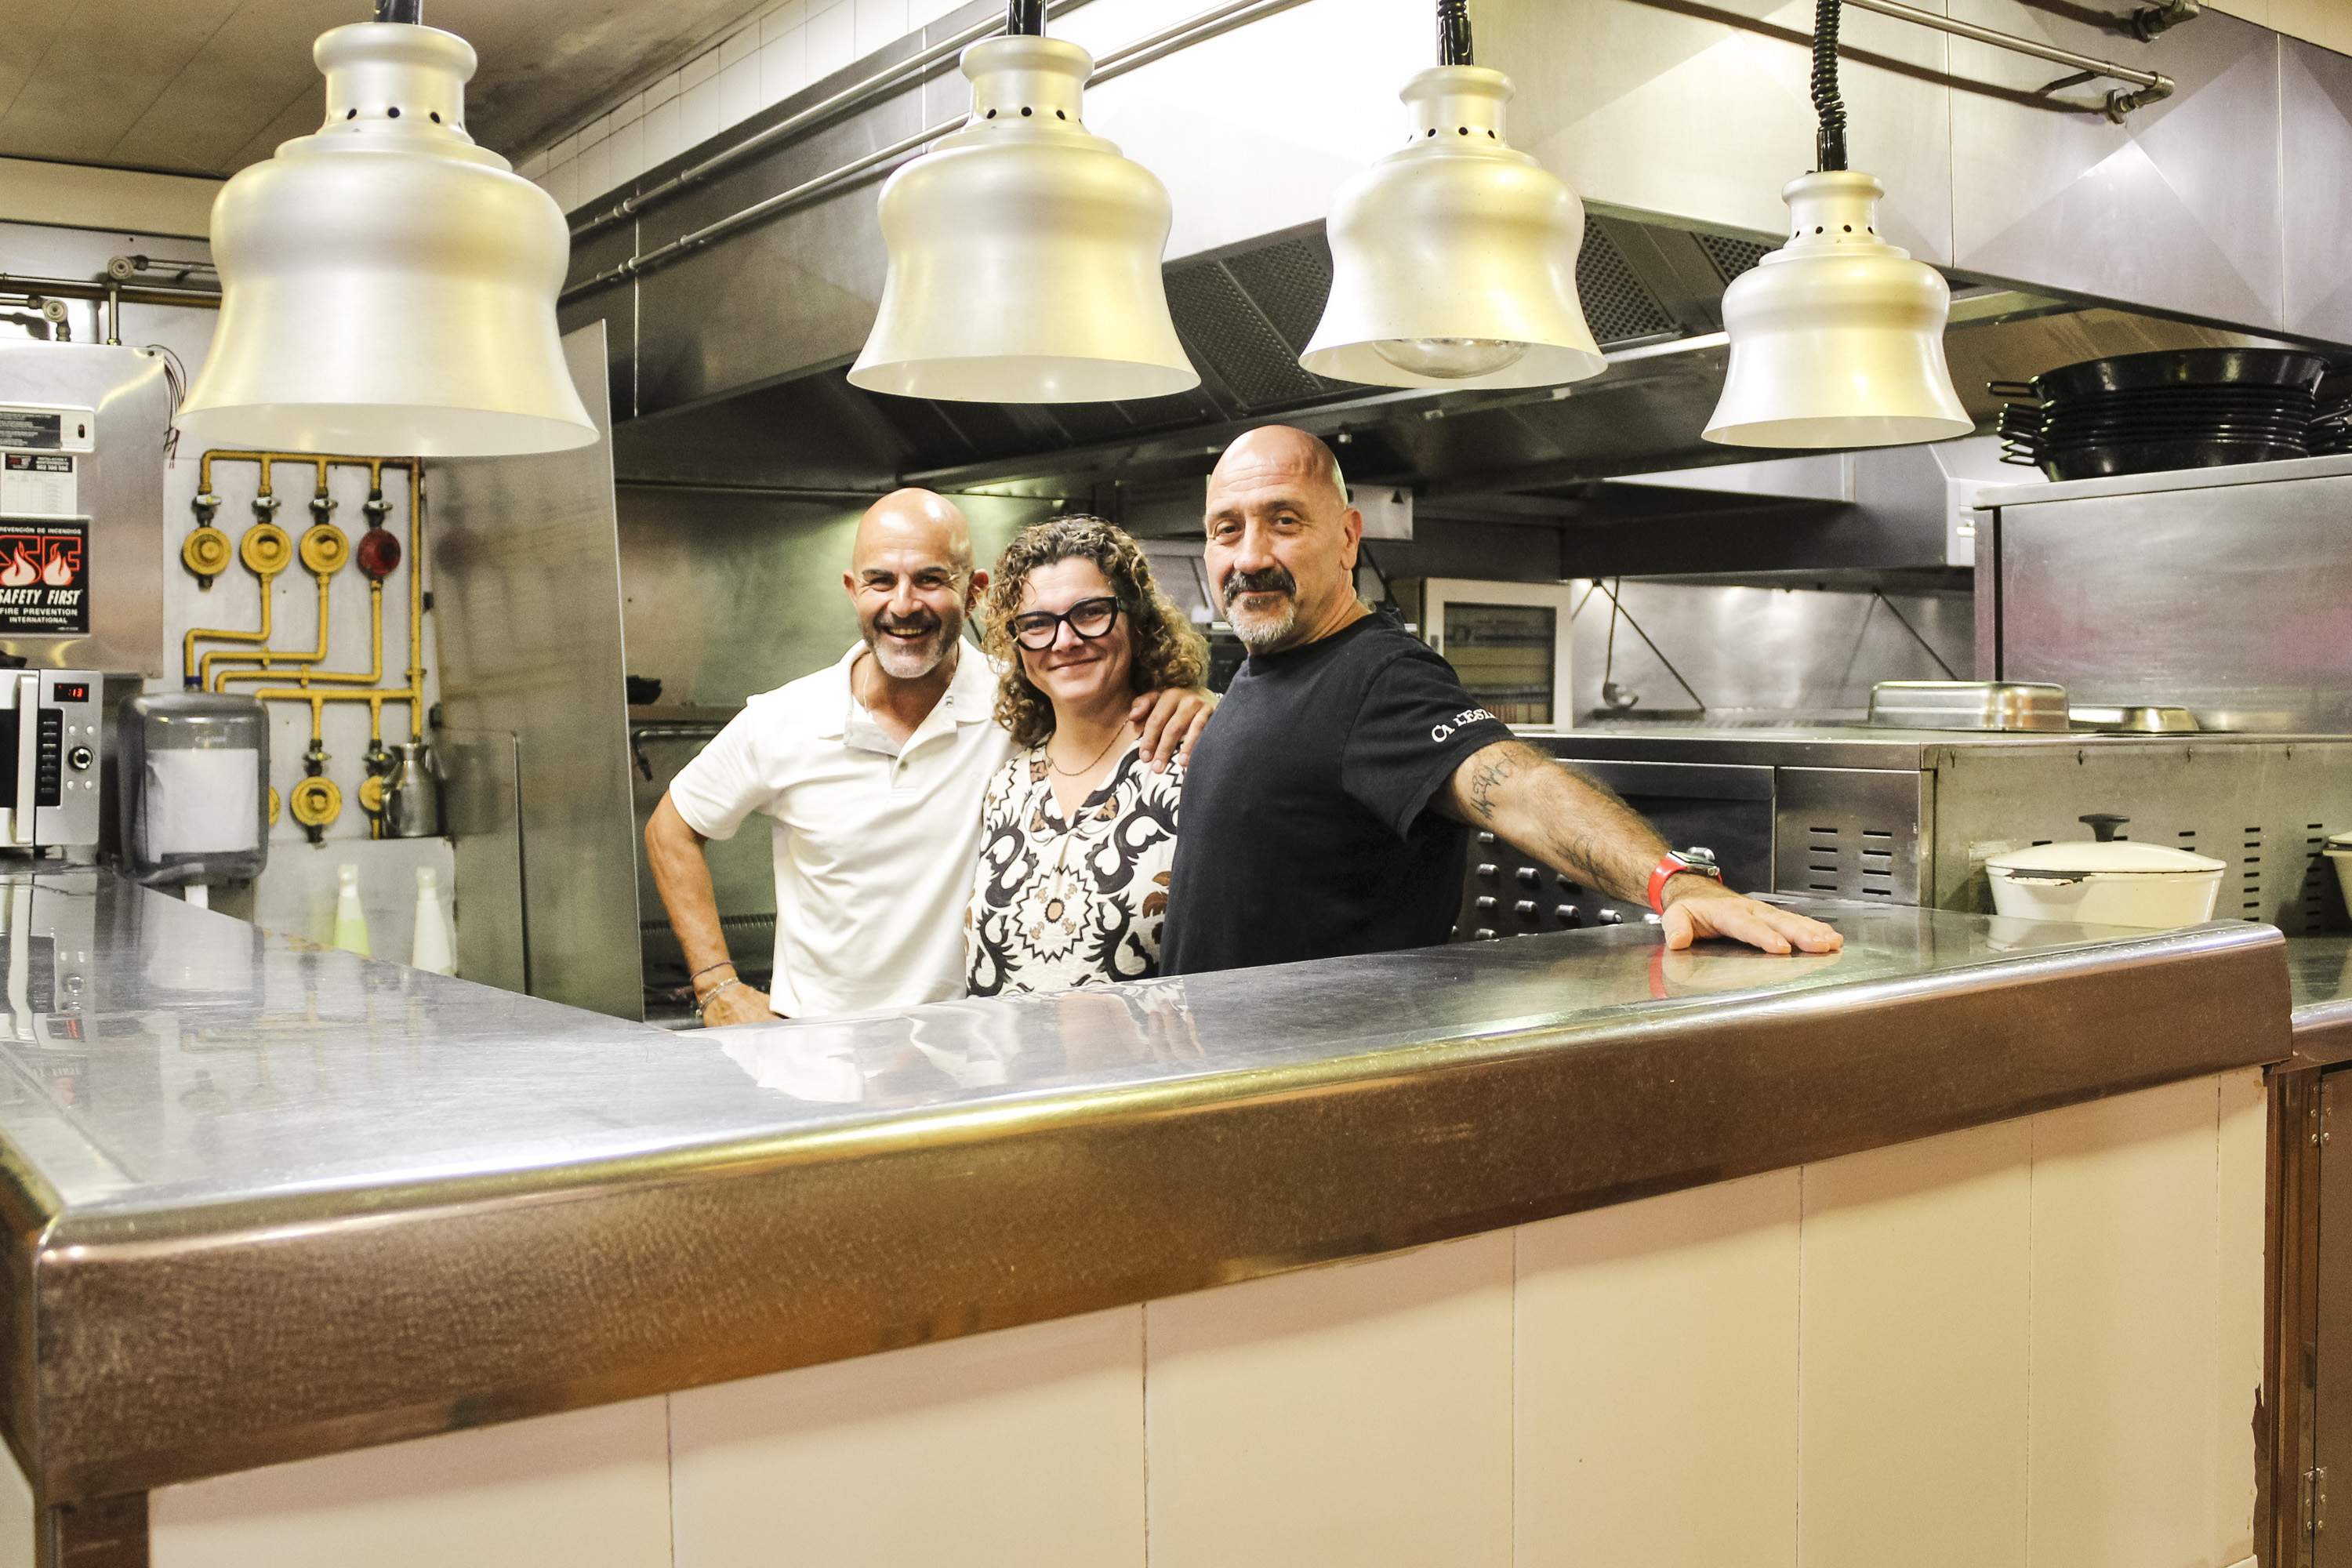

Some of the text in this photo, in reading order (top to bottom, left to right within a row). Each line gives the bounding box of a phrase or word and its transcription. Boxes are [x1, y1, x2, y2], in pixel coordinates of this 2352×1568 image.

[0, 588, 81, 605] SAFETY FIRST
[0, 607, 78, 617] FIRE PREVENTION
